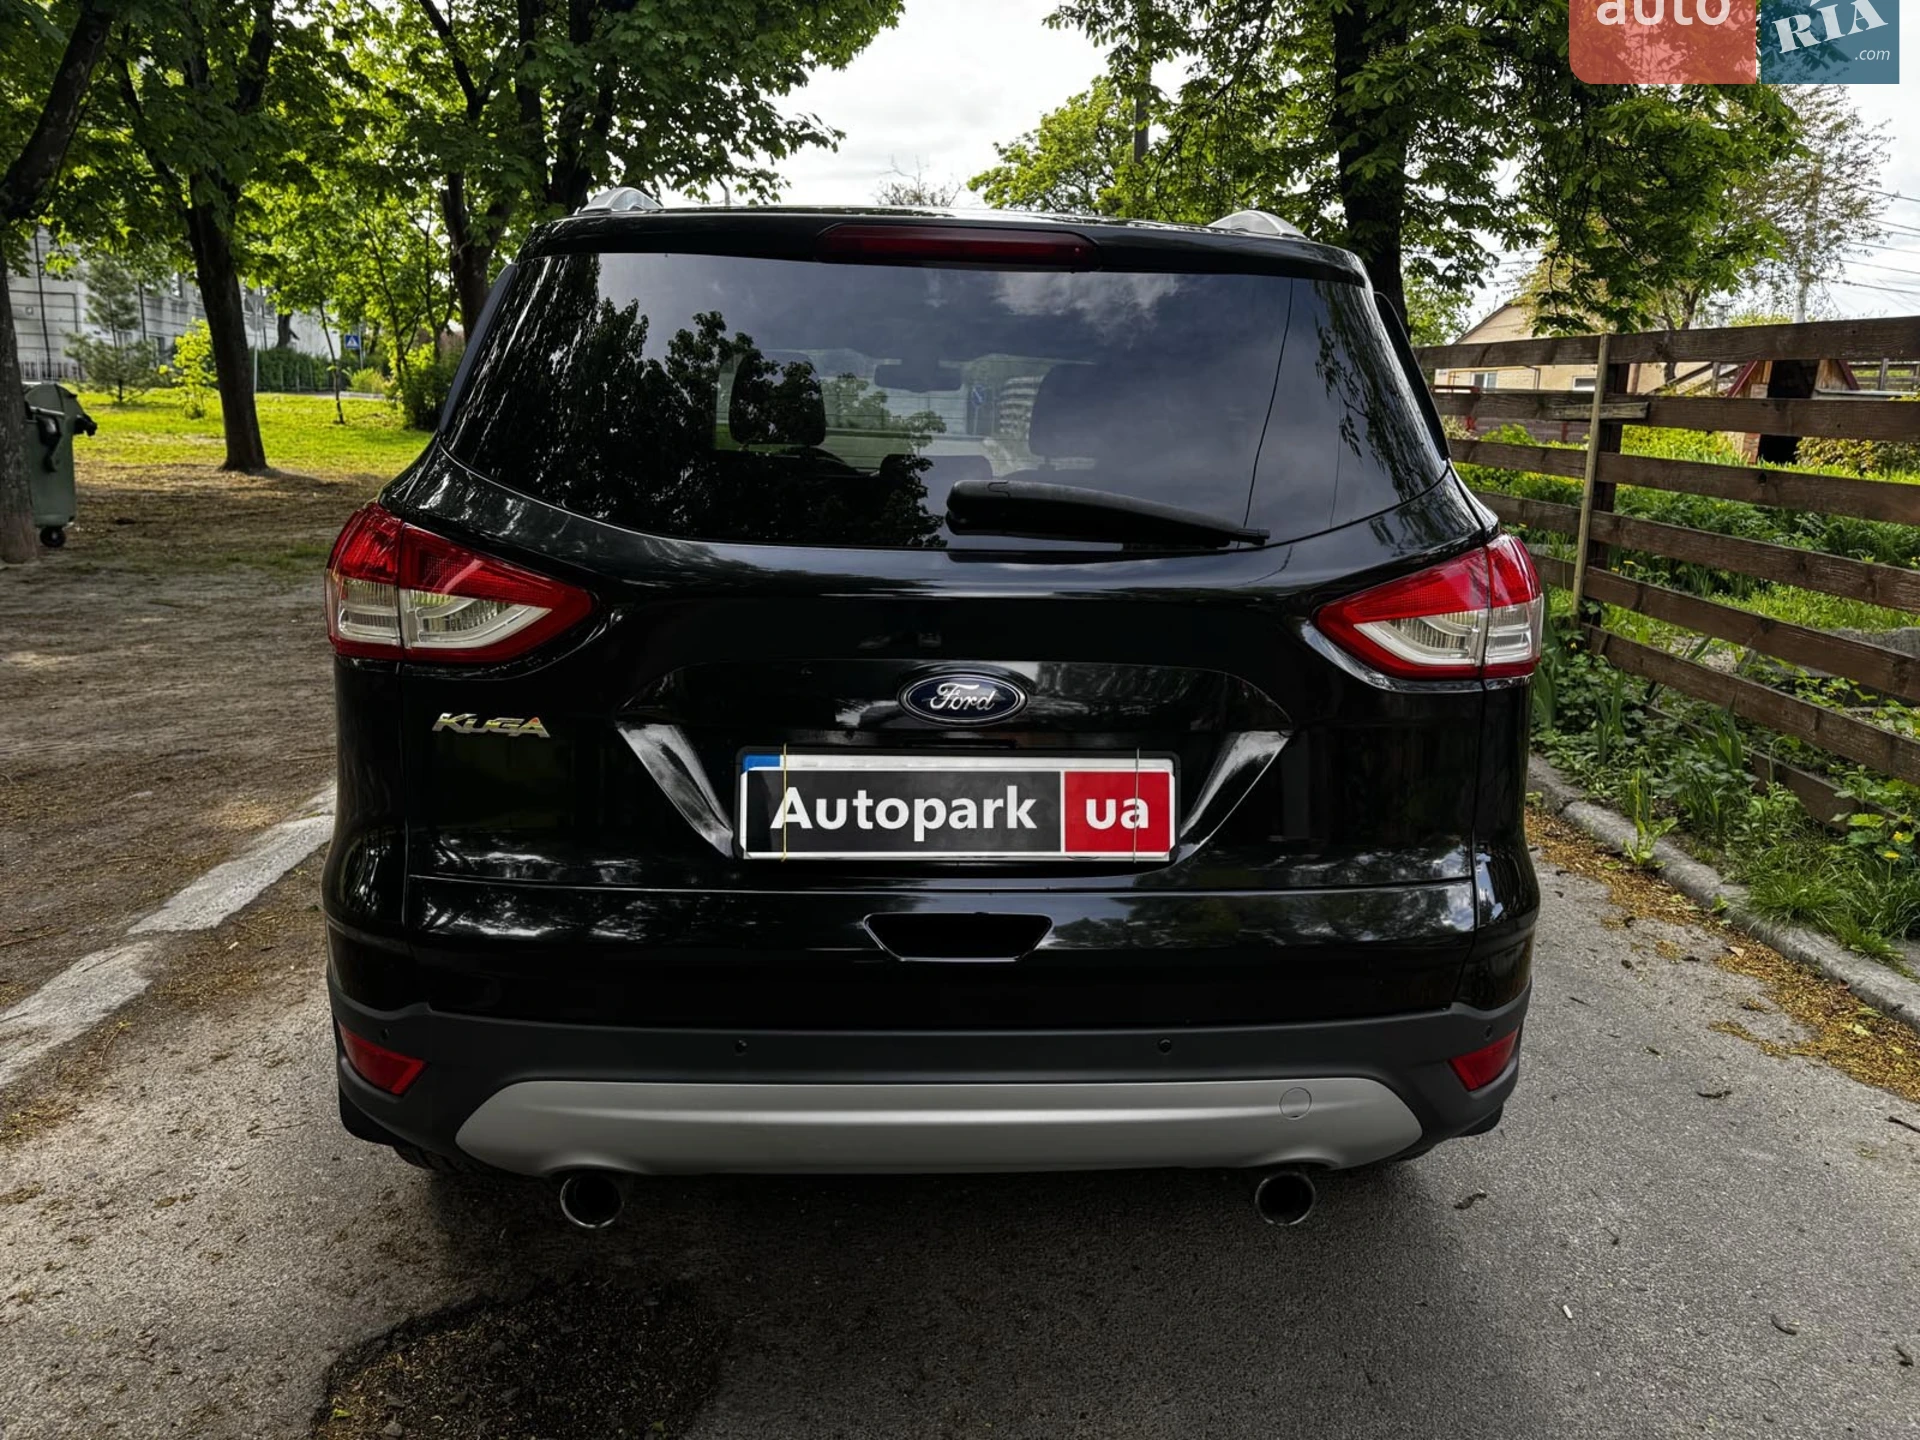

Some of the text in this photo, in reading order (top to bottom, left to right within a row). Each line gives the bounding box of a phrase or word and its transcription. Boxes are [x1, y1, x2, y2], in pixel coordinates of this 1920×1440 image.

[925, 682, 997, 710] Ford
[770, 785, 1149, 842] Autopark ua
